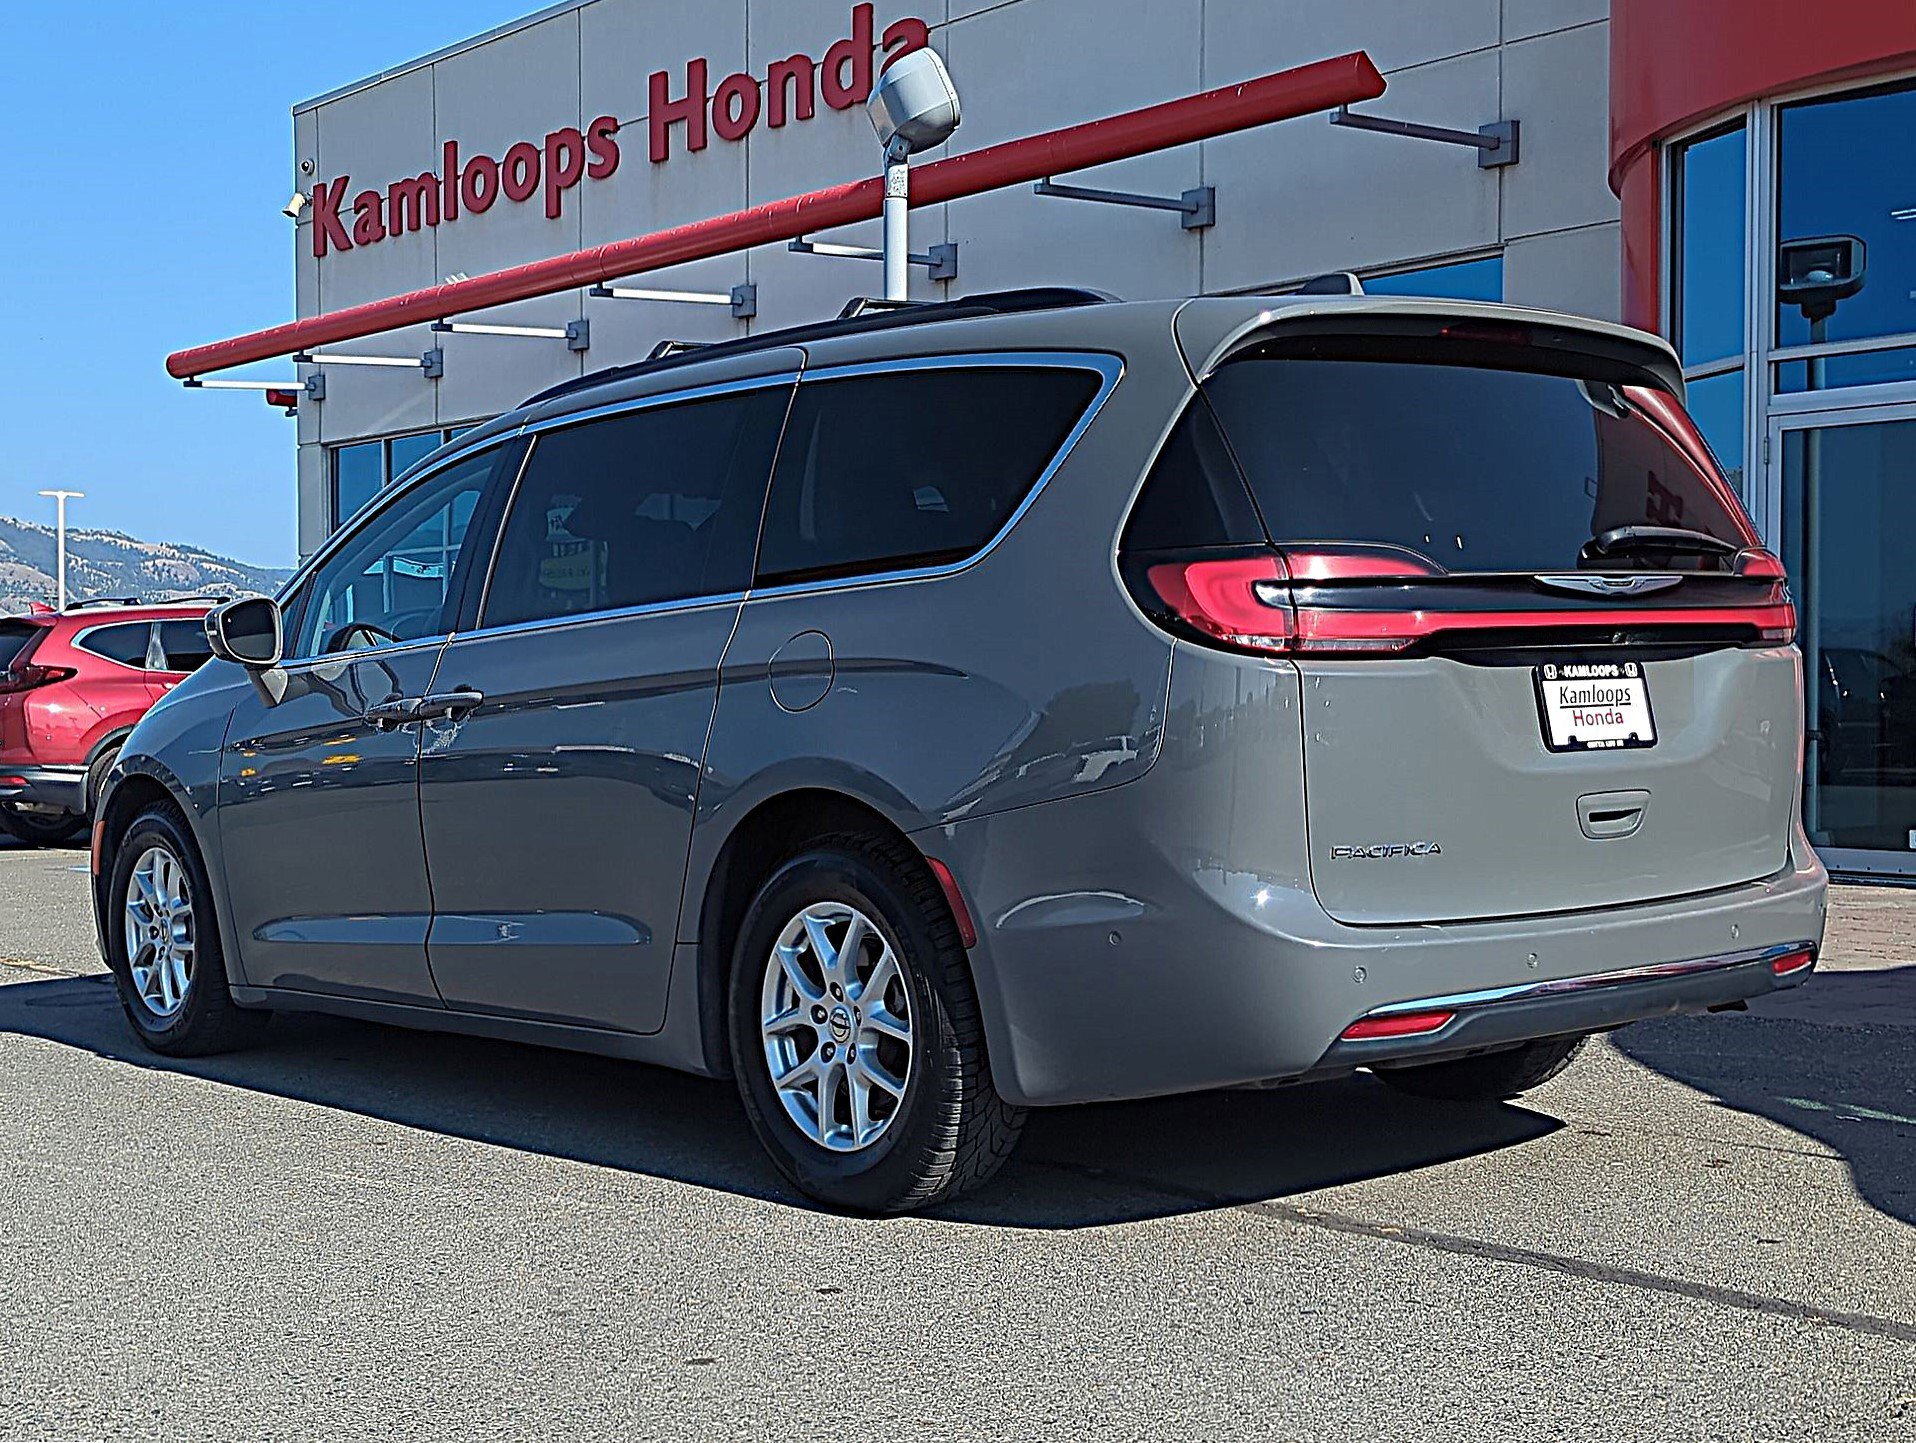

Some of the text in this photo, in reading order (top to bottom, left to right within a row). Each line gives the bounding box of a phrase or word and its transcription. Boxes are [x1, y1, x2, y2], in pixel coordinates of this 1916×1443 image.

[313, 115, 620, 257] Kamloops
[1564, 664, 1619, 677] KAMLOOPS
[1559, 684, 1631, 707] Kamloops
[1572, 708, 1624, 727] Honda
[1330, 841, 1441, 860] PACIFICA
